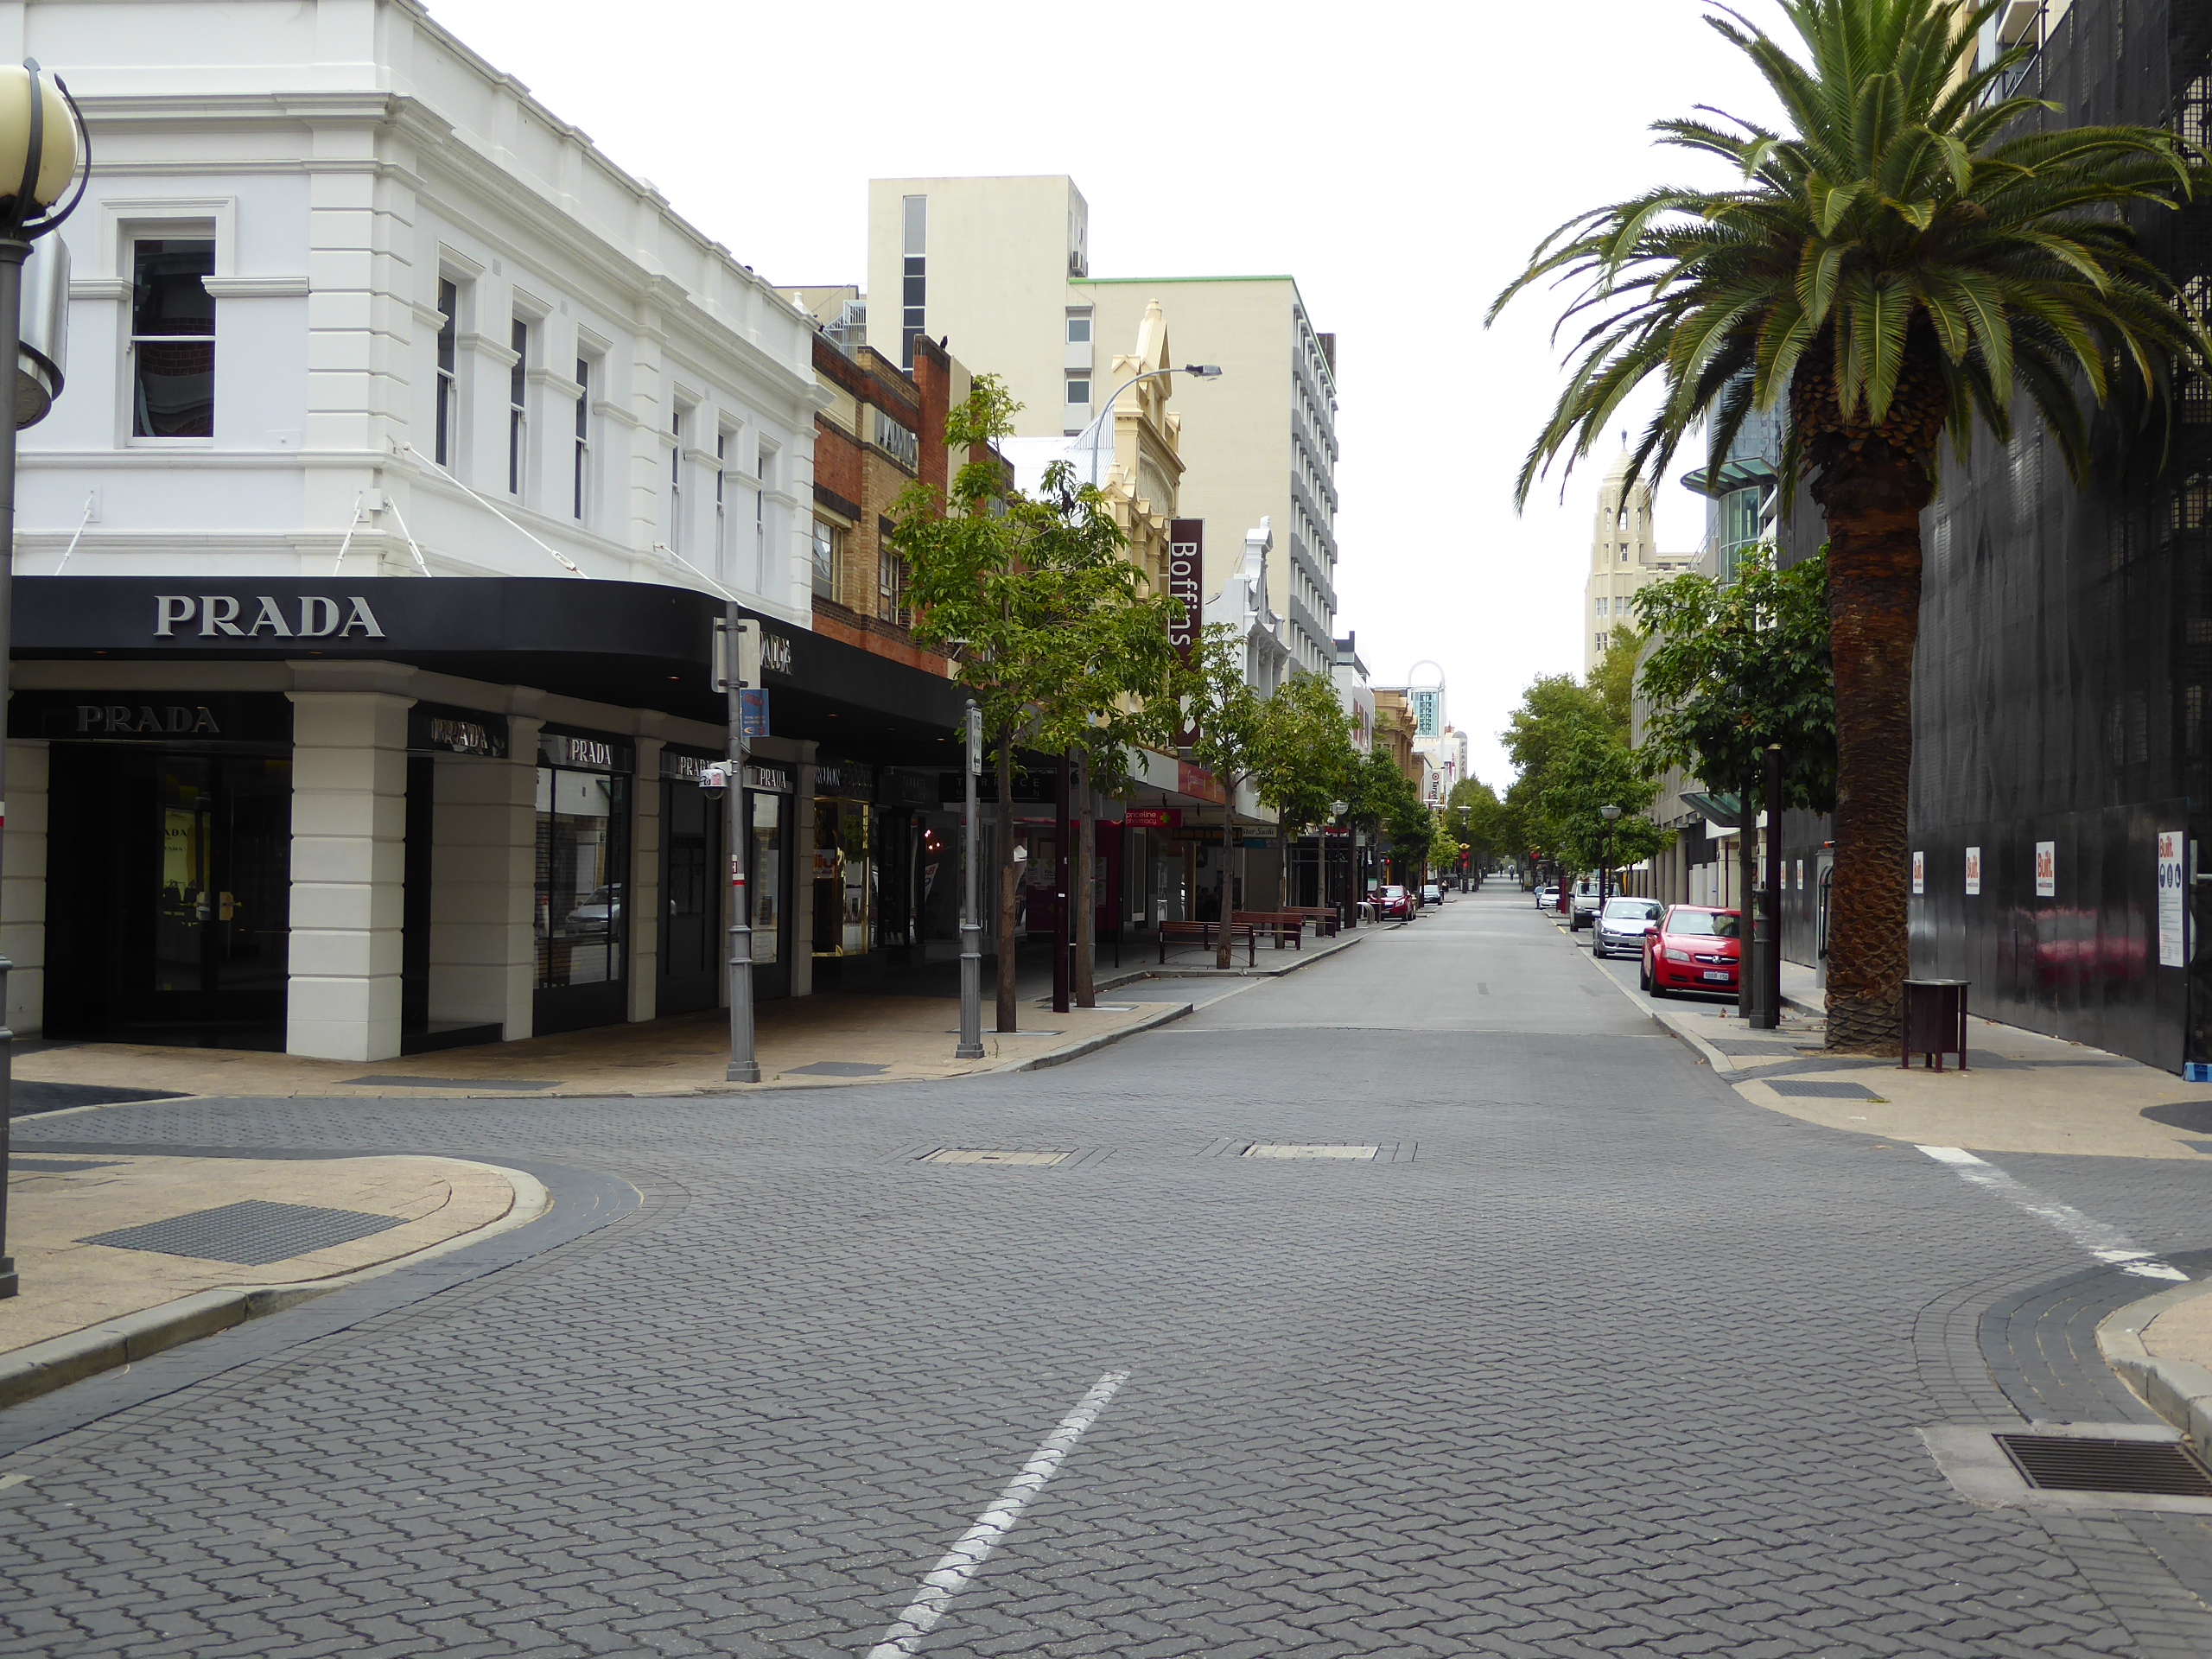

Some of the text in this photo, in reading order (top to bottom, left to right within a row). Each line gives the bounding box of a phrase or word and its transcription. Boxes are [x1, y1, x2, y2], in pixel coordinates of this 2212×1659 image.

[153, 595, 386, 638] PRADA
[760, 631, 792, 675] ADA
[76, 705, 220, 733] PRADA
[433, 718, 488, 749] PRADA
[567, 739, 611, 765] PRADA
[677, 756, 711, 776] PRAD
[760, 766, 786, 788] PRADA
[815, 766, 841, 786] ROTON
[956, 778, 1039, 787] TRRCE
[1126, 810, 1157, 819] priceline
[1255, 827, 1274, 836] Sushi
[2037, 850, 2053, 878] Built.
